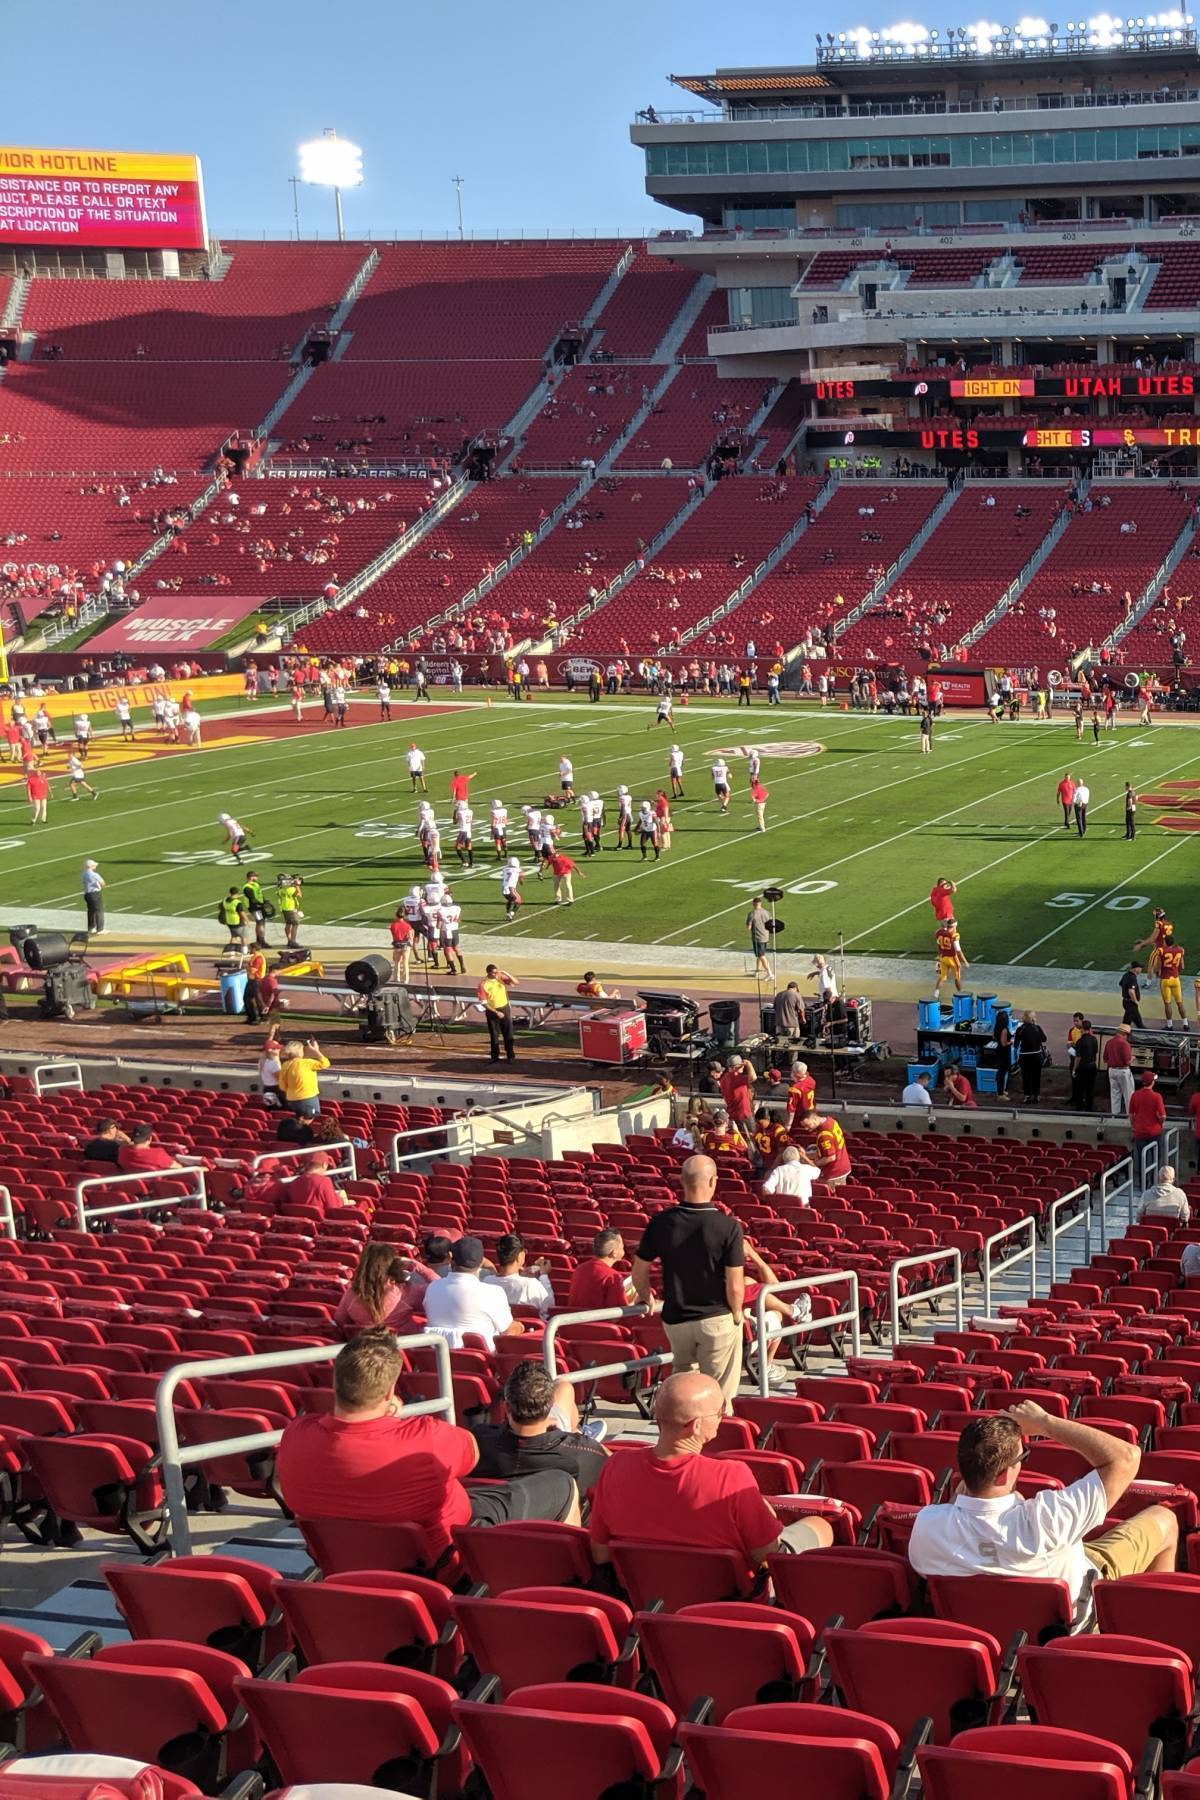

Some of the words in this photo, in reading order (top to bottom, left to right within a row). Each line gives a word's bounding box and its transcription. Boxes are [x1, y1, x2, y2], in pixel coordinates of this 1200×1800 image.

[41, 154, 117, 172] HOTLINE
[64, 181, 81, 193] OR
[84, 182, 100, 194] TO
[104, 183, 151, 195] REPORT
[155, 185, 179, 196] ANY
[32, 194, 79, 206] PLEASE
[82, 195, 113, 208] CALL
[117, 197, 134, 208] OR
[137, 197, 167, 209] TEXT
[69, 208, 84, 220] OF
[87, 208, 111, 221] THE
[115, 209, 177, 222] SITUATION
[18, 220, 79, 232] LOCATION
[1179, 229, 1193, 237] 404
[851, 239, 863, 247] 401
[940, 237, 953, 245] 402
[1062, 233, 1076, 241] 403
[817, 381, 854, 399] UTES
[966, 381, 998, 395] IGHT
[1066, 377, 1121, 396] UTAH
[1137, 376, 1194, 395] UTES
[922, 430, 979, 449] UTES
[123, 618, 234, 631] MUSCLE
[126, 630, 200, 641] MILK
[88, 688, 141, 710] FIGHT
[143, 685, 173, 703] ON!
[732, 878, 839, 894] 40
[1044, 892, 1151, 911] 50
[1164, 952, 1182, 967] 24
